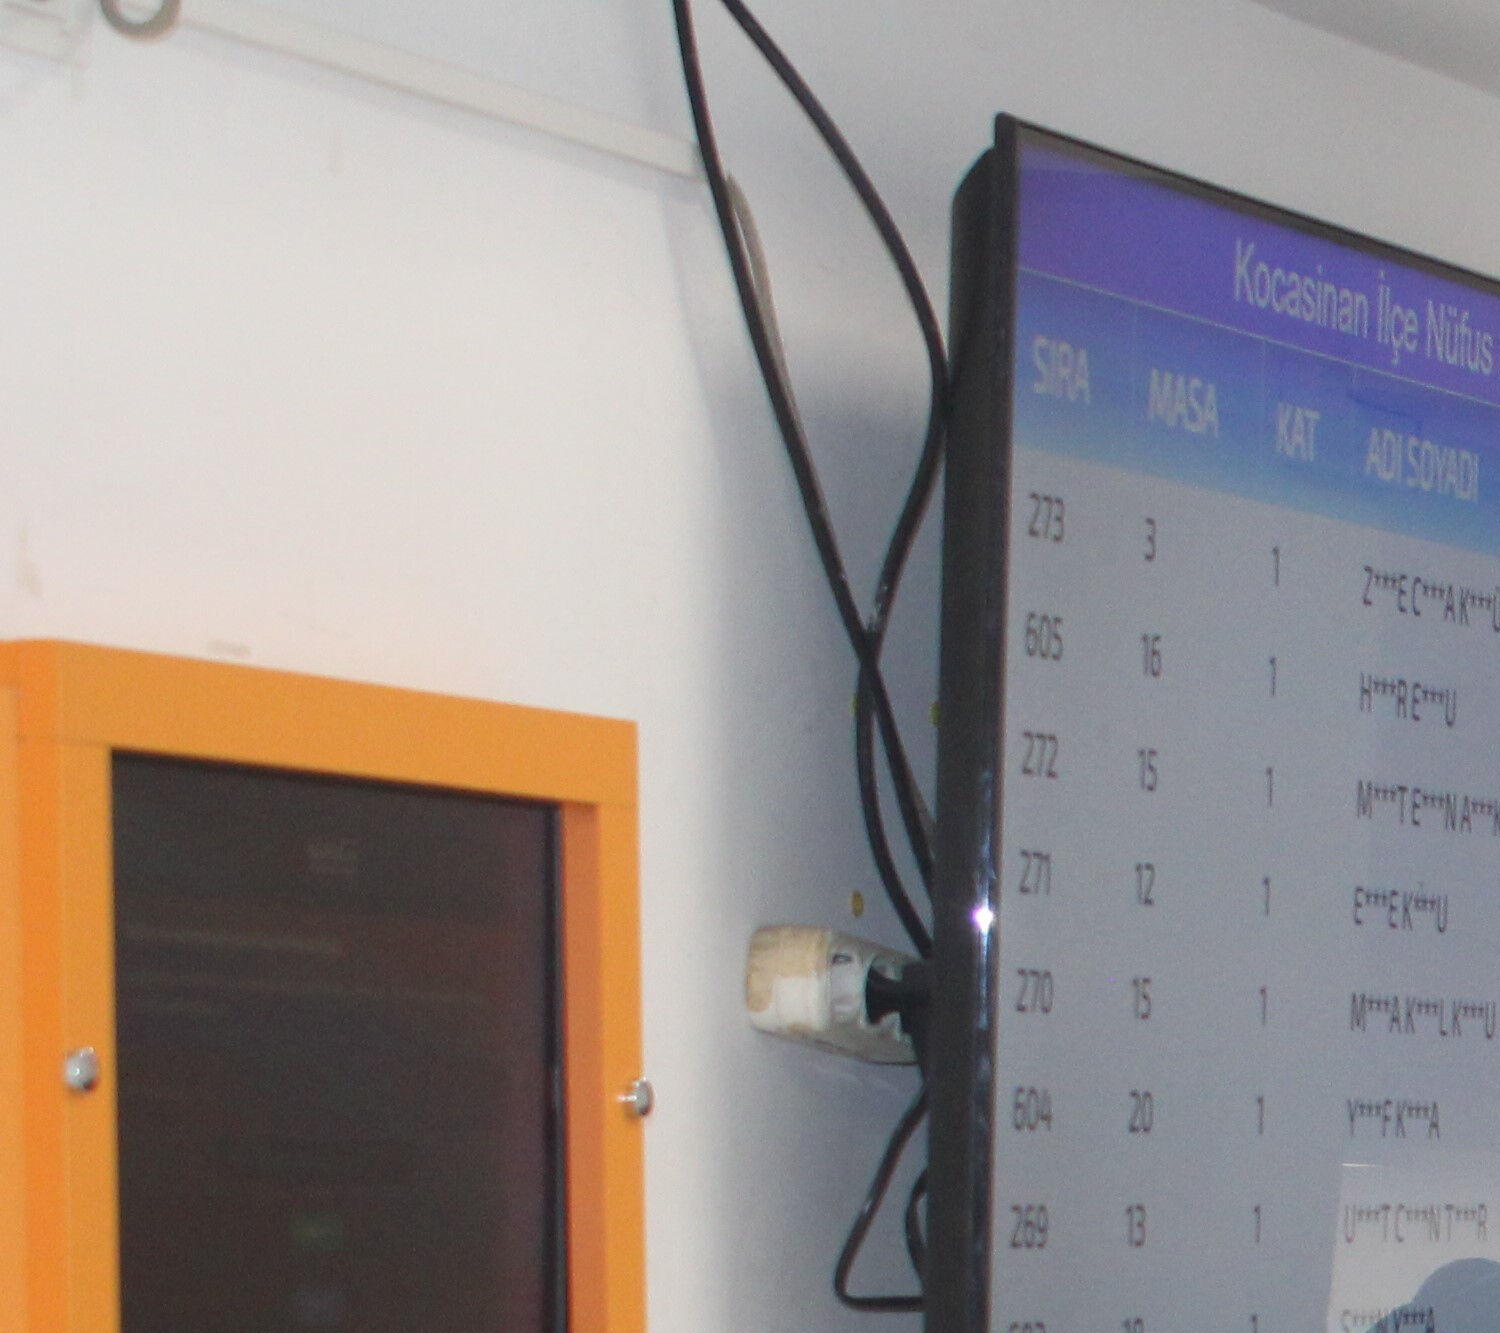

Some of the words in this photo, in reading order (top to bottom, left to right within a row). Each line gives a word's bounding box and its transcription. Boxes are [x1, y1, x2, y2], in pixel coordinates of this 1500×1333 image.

[1235, 238, 1369, 338] Kocasinan
[1376, 269, 1419, 365] İlçe
[1426, 299, 1494, 376] Nüfus
[1032, 334, 1091, 405] SIRA
[1149, 366, 1220, 438] MASA
[1275, 402, 1321, 460] KAT
[1364, 426, 1403, 482] ADI
[1406, 435, 1479, 504] SOYADI
[1028, 492, 1065, 543] 273
[1144, 517, 1156, 562] 3
[1271, 545, 1280, 587] 1
[1025, 612, 1064, 661] 605
[1141, 632, 1162, 679] 16
[1269, 655, 1278, 697] 1
[1022, 730, 1059, 779] 272
[1137, 749, 1158, 792] 15
[1265, 767, 1273, 807] 1
[1018, 849, 1051, 895] 271
[1134, 862, 1156, 906] 12
[1262, 876, 1271, 918] 1
[1015, 968, 1055, 1014] 270
[1132, 977, 1152, 1020] 15
[1260, 985, 1268, 1026] 1
[1012, 1086, 1053, 1132] 604
[1129, 1088, 1153, 1134] 20
[1256, 1094, 1264, 1136] 1
[1010, 1204, 1048, 1249] 269
[1125, 1203, 1146, 1248] 13
[1253, 1203, 1261, 1244] 1
